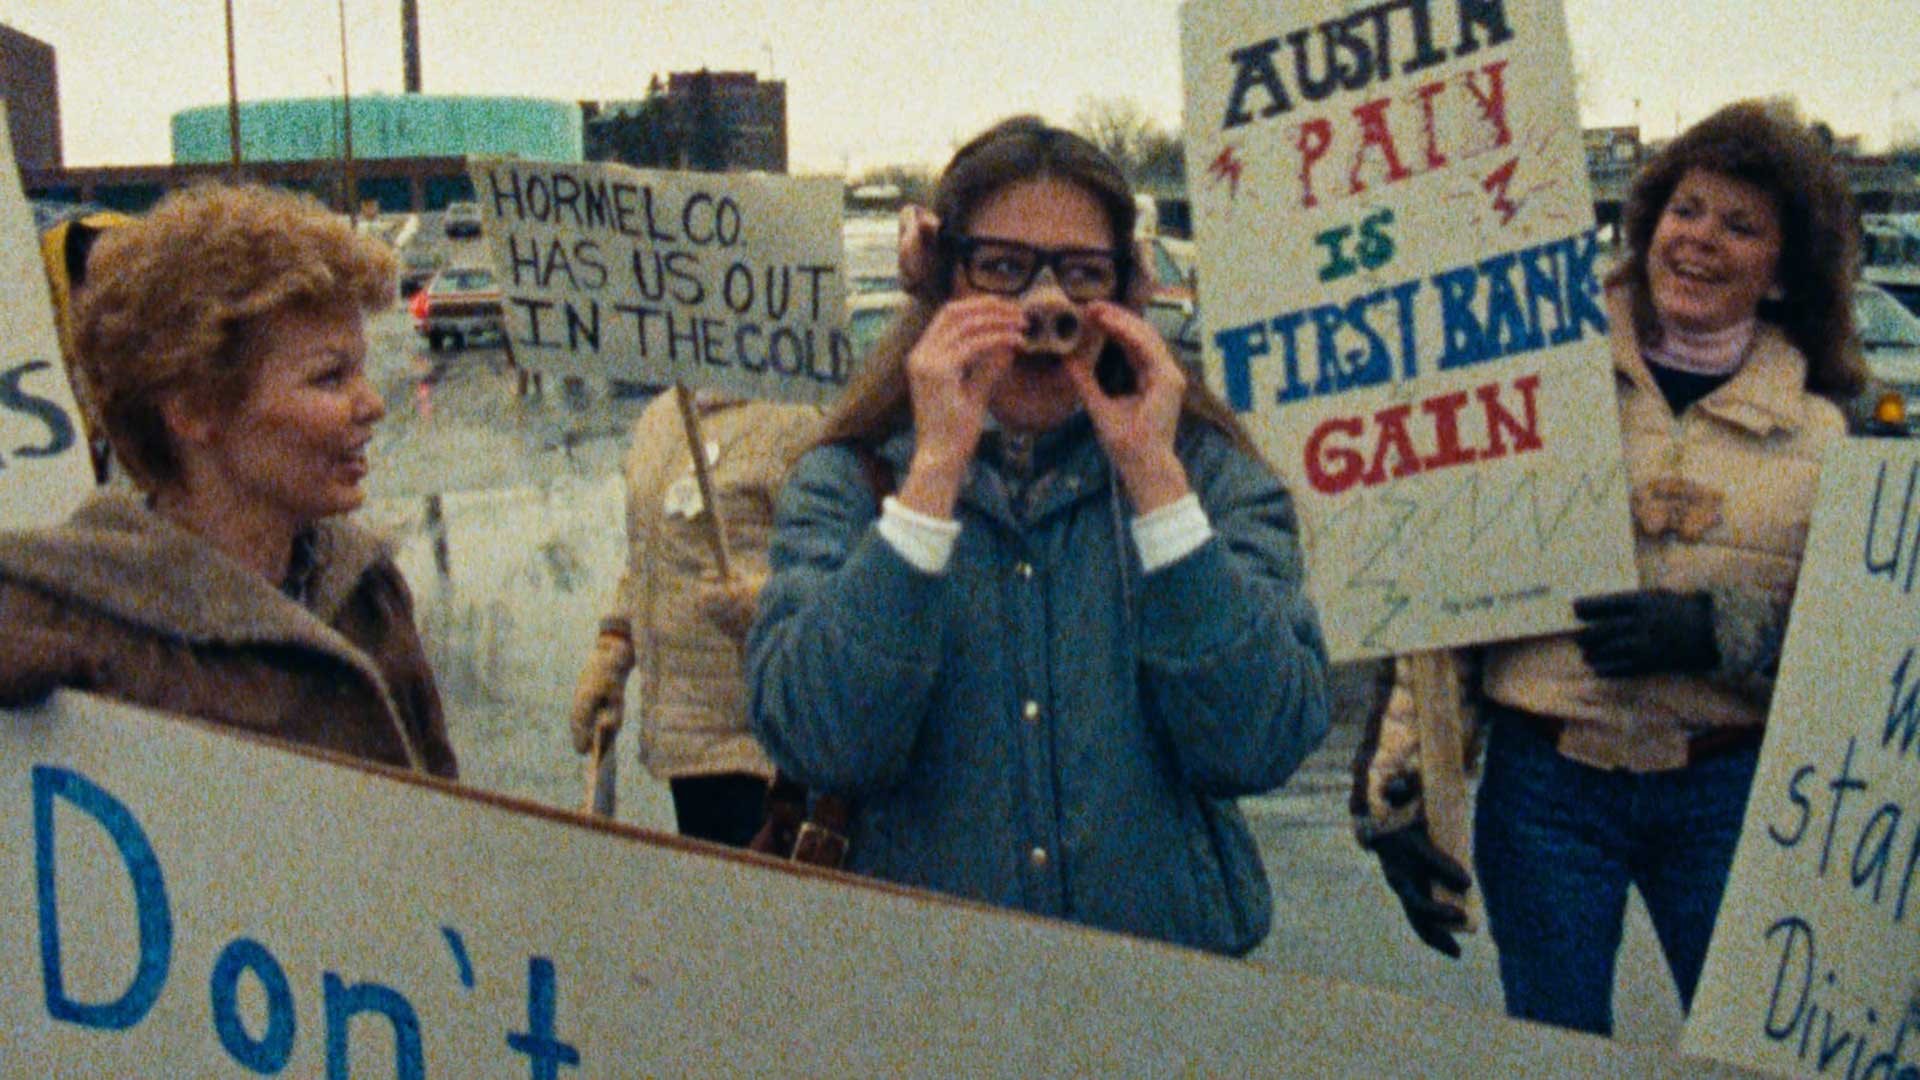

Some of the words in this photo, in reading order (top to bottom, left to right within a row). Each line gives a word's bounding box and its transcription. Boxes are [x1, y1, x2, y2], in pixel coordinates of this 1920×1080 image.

[1221, 0, 1516, 129] AUSTIN
[488, 163, 676, 243] HORMEL
[1313, 208, 1396, 284] IS
[507, 233, 609, 291] HAS
[631, 247, 706, 306] US
[722, 261, 836, 321] OUT
[508, 295, 600, 353] IN
[1213, 279, 1422, 414] FIRST
[1430, 227, 1610, 372] BANK
[1303, 374, 1544, 494] GAIN
[31, 764, 581, 1080] Don't
[1764, 916, 1920, 1080] Divid
